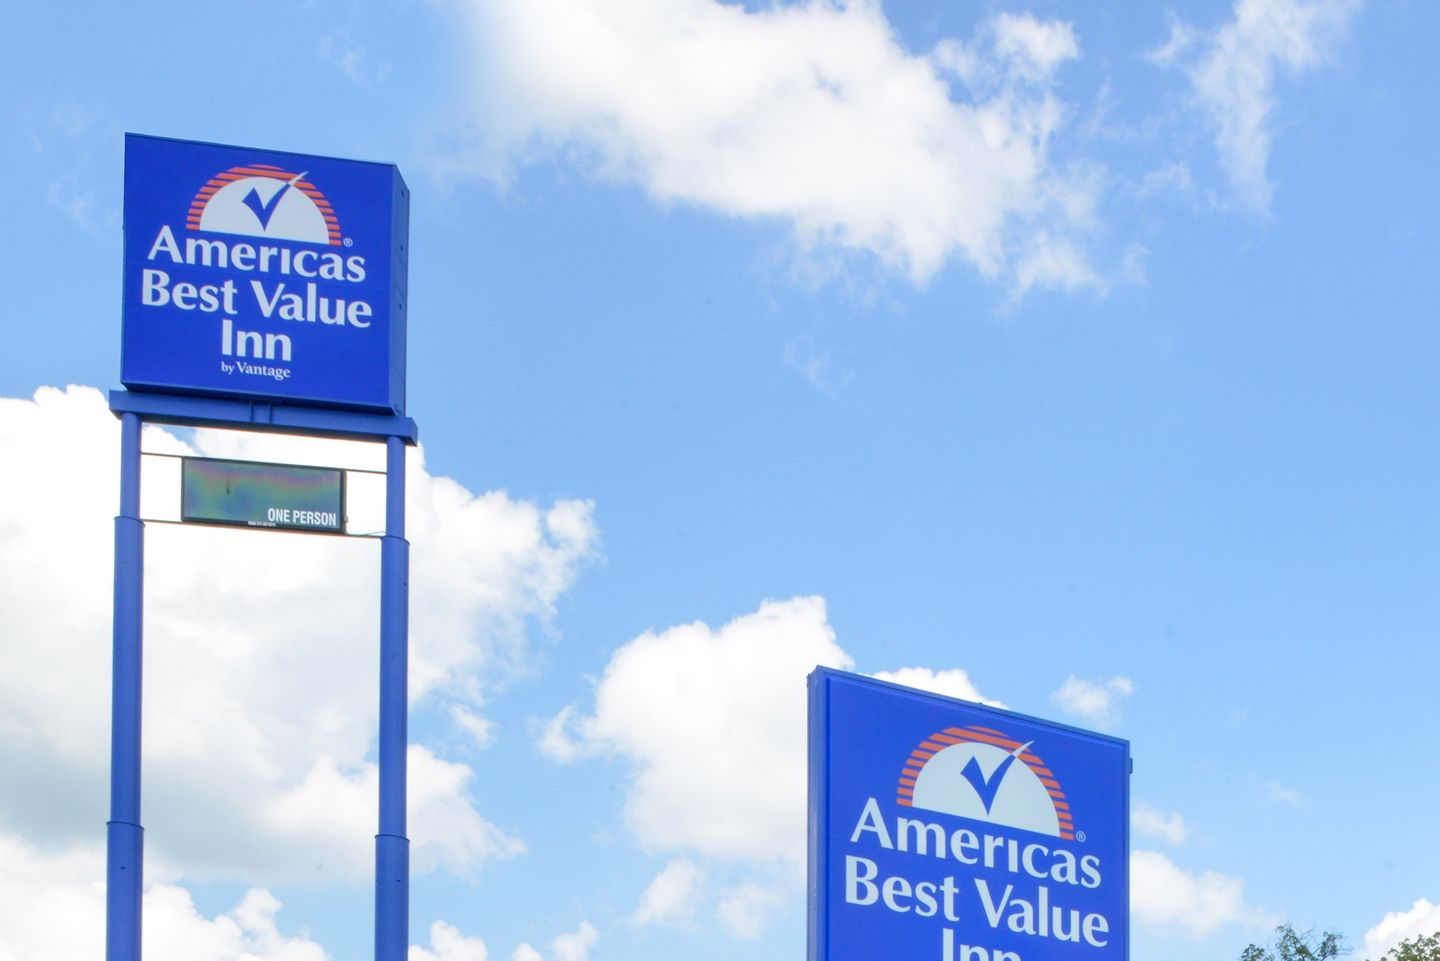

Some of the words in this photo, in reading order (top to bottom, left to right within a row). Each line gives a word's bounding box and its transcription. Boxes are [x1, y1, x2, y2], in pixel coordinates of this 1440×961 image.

[147, 224, 366, 283] Americas
[141, 268, 238, 315] Best
[250, 280, 373, 328] Value
[221, 318, 292, 362] Inn
[221, 361, 235, 375] by
[236, 361, 291, 380] Vantage
[267, 508, 290, 523] ONE
[293, 511, 337, 526] PERSON
[850, 797, 1101, 889] Americas
[845, 854, 960, 922] Best
[974, 878, 1109, 948] Value
